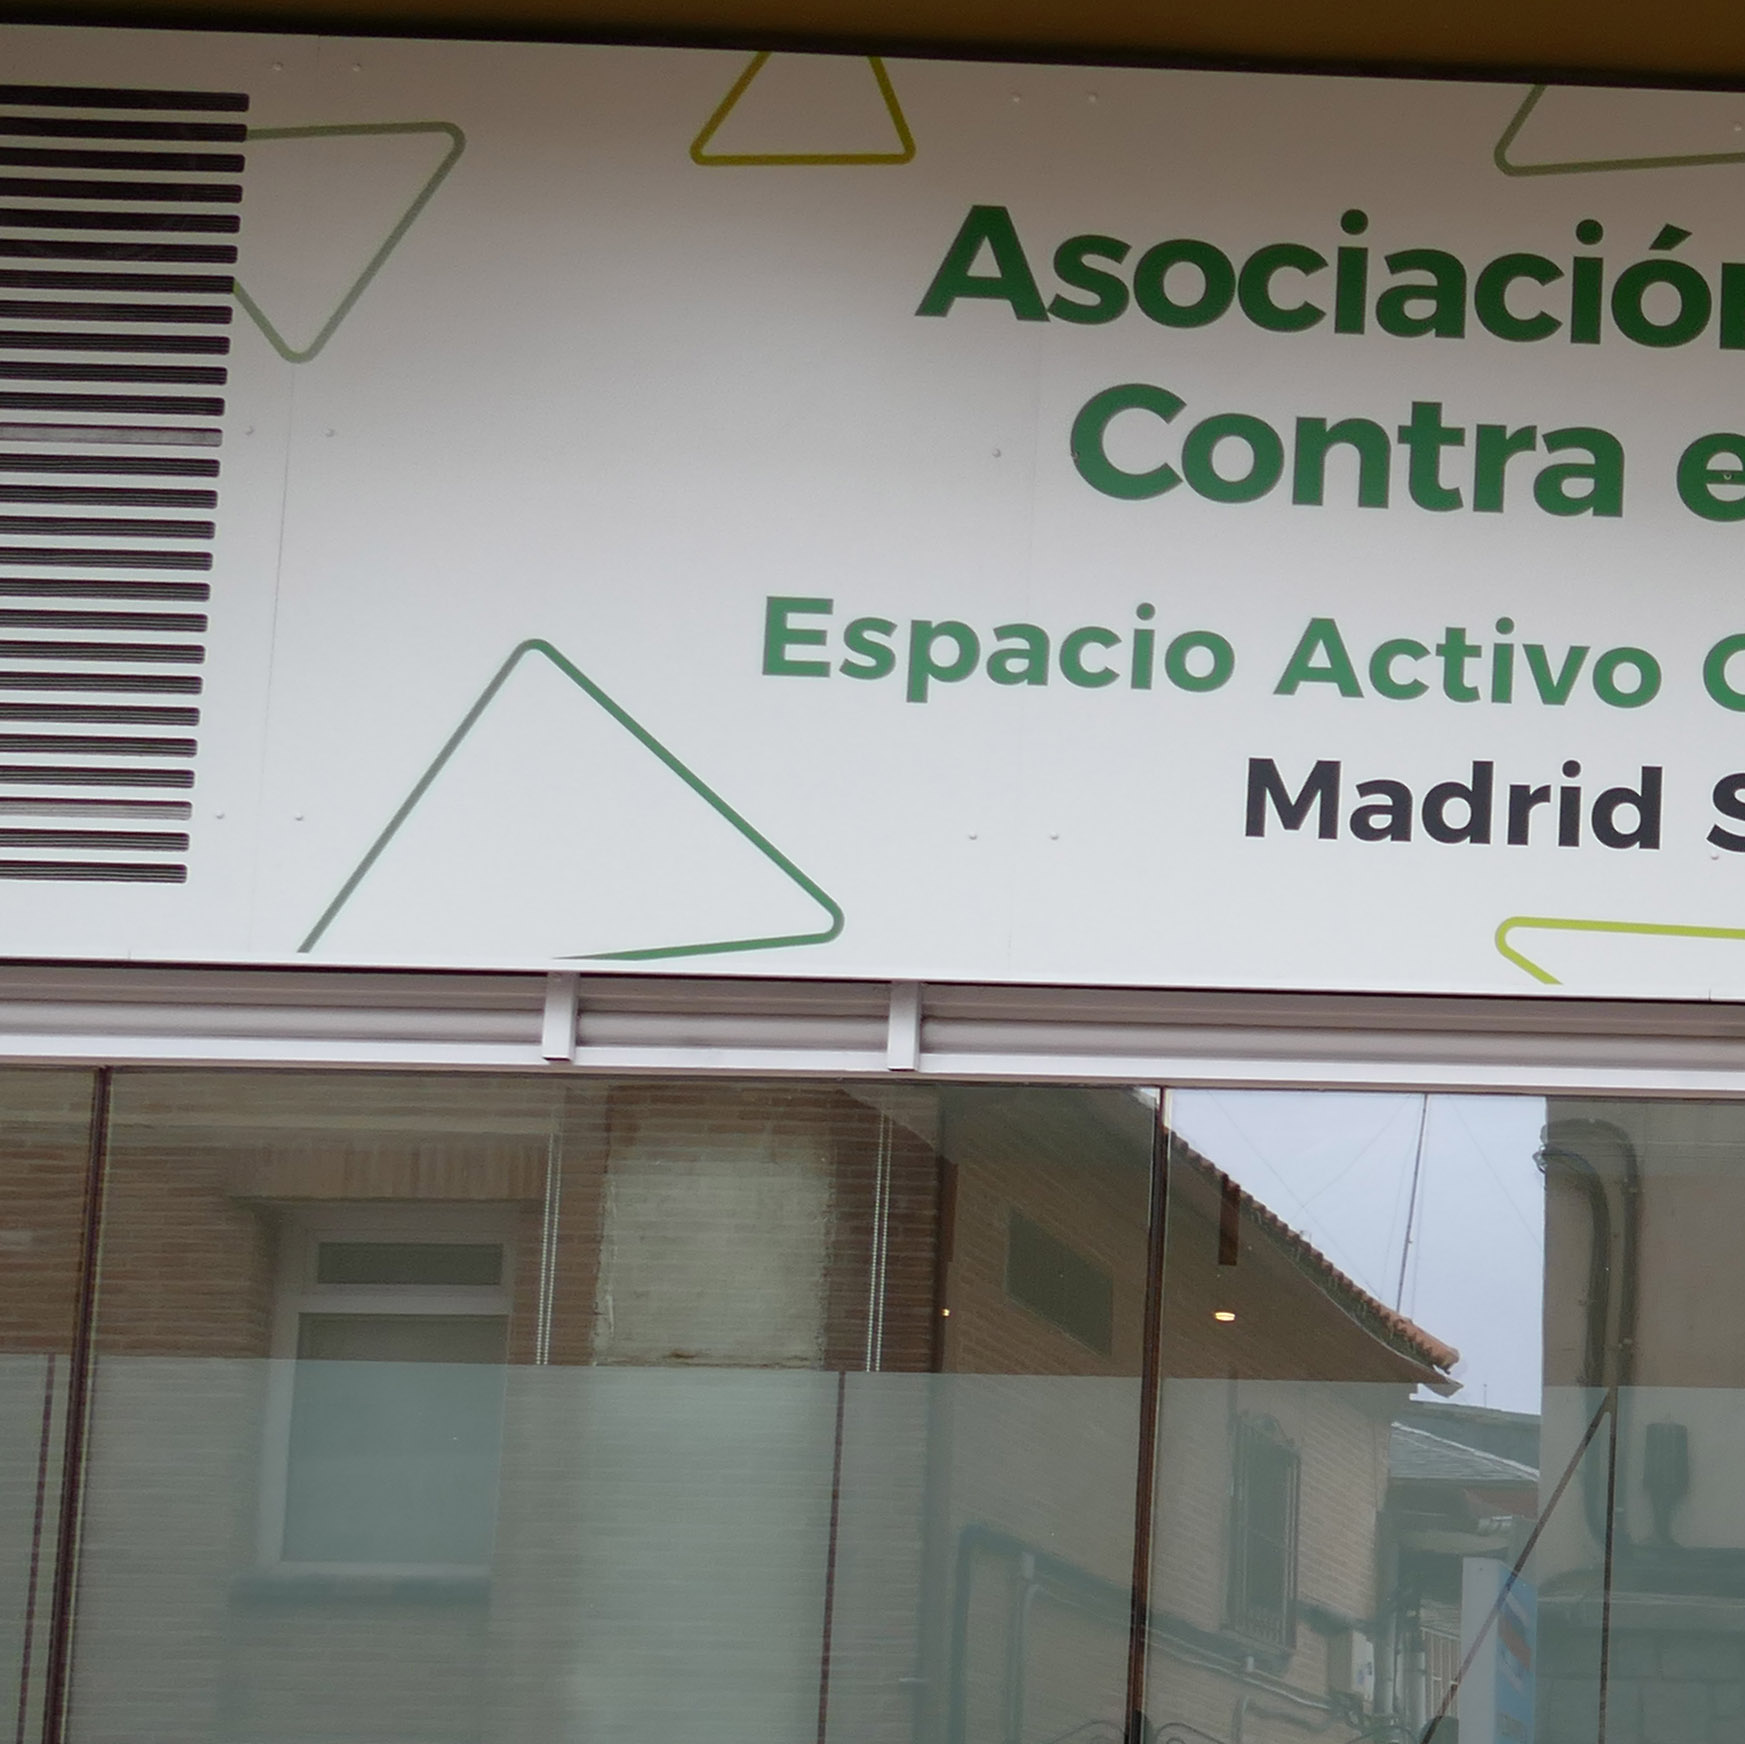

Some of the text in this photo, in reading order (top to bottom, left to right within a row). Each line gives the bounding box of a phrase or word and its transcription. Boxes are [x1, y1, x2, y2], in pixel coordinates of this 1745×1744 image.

[1070, 383, 1624, 517] Contra
[762, 596, 1235, 703] Espacio
[1273, 617, 1661, 708] Activo
[1245, 757, 1663, 850] Madrid
